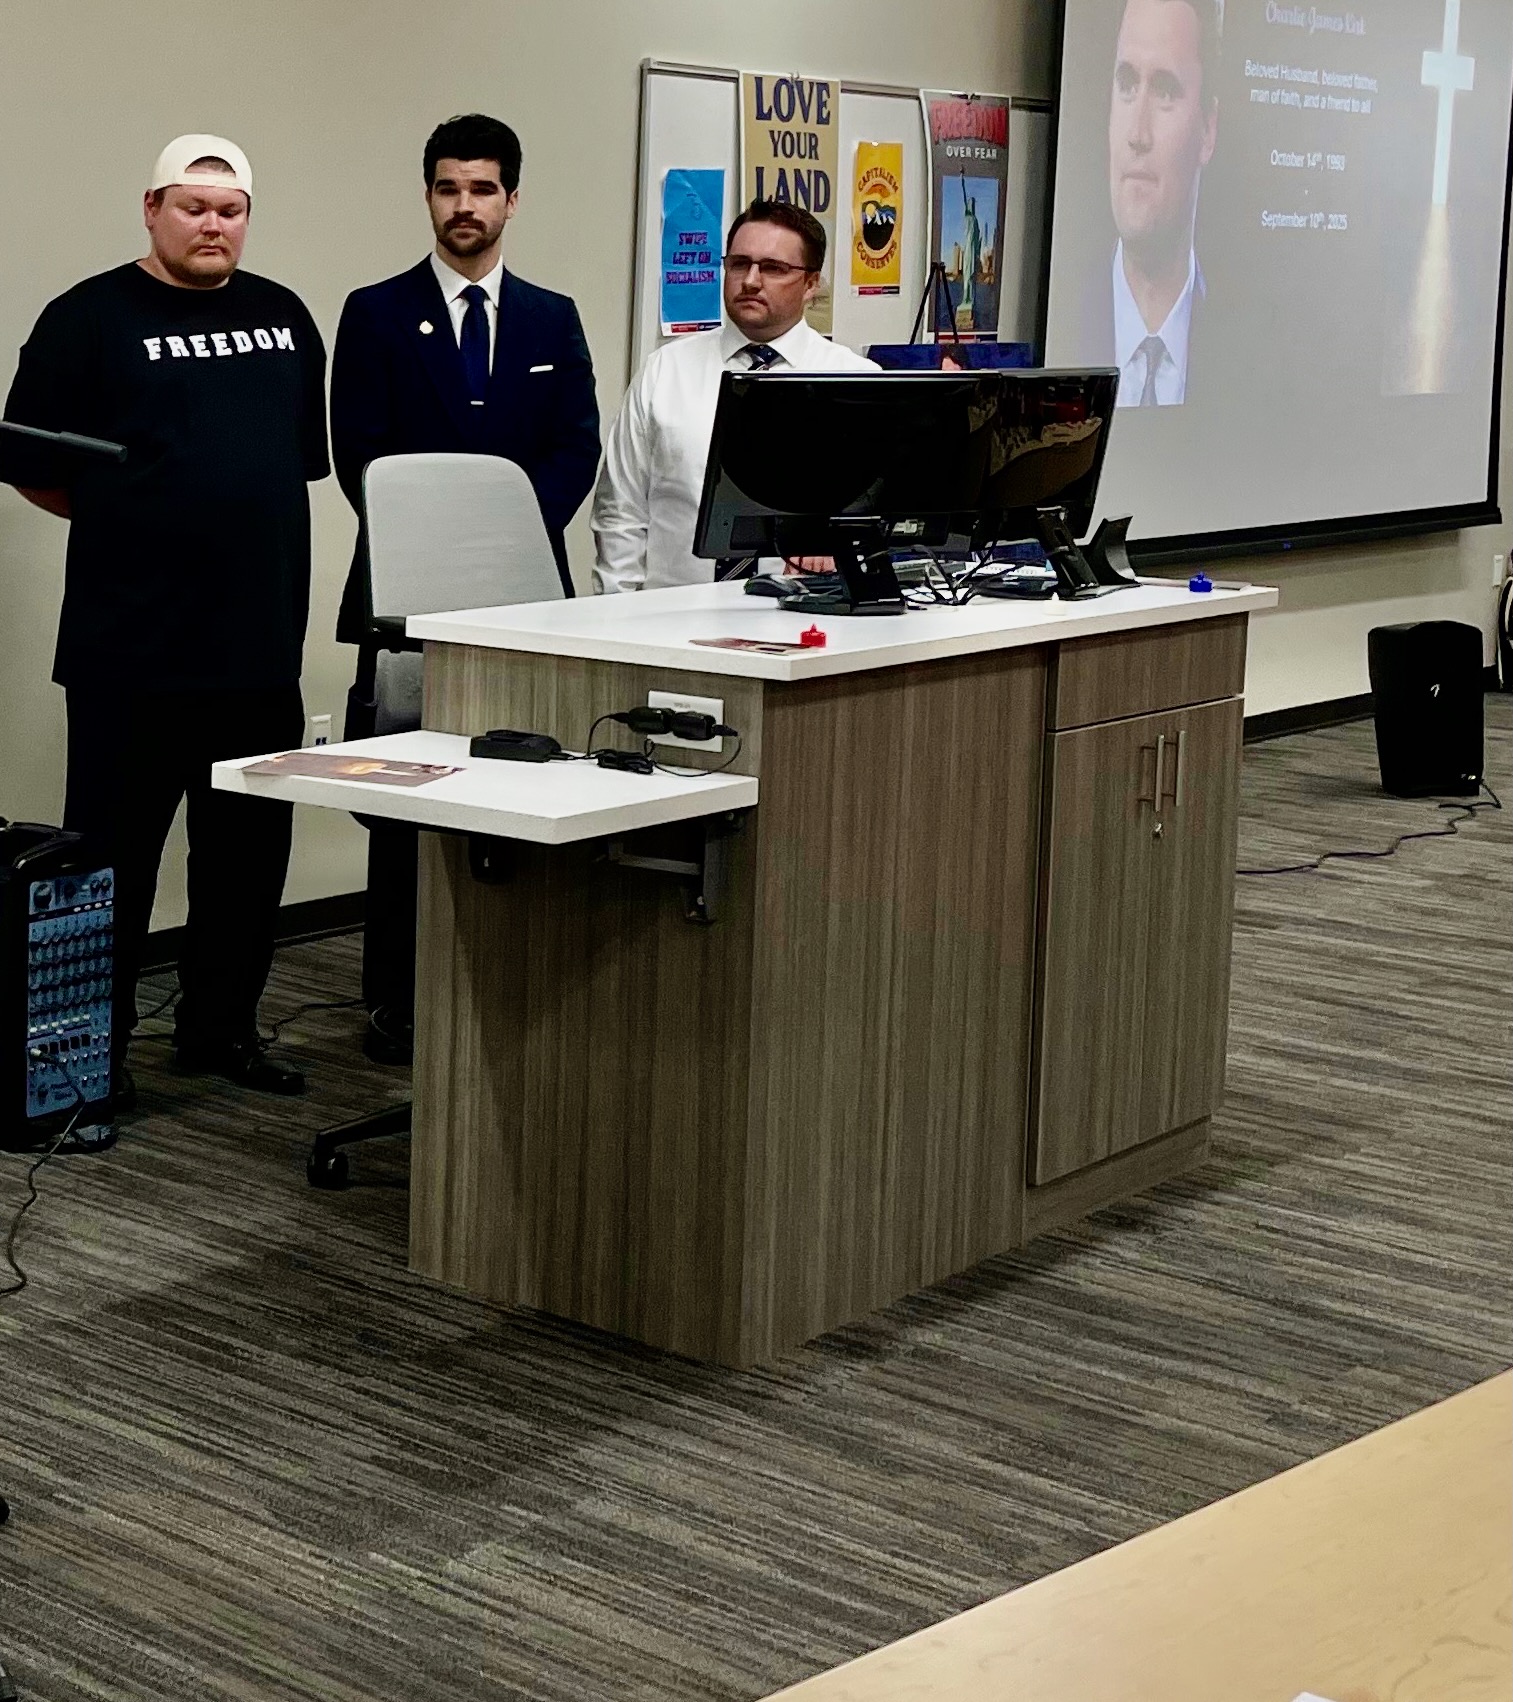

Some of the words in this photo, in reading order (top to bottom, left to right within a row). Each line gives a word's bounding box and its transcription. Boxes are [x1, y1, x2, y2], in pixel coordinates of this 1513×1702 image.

[754, 76, 831, 125] LOVE
[769, 130, 819, 160] YOUR
[946, 146, 972, 158] OVER
[974, 147, 997, 160] FEAR
[755, 166, 831, 213] LAND
[858, 167, 899, 193] CAPITALISM
[672, 252, 697, 265] LEFT
[143, 326, 296, 361] FREEDOM
